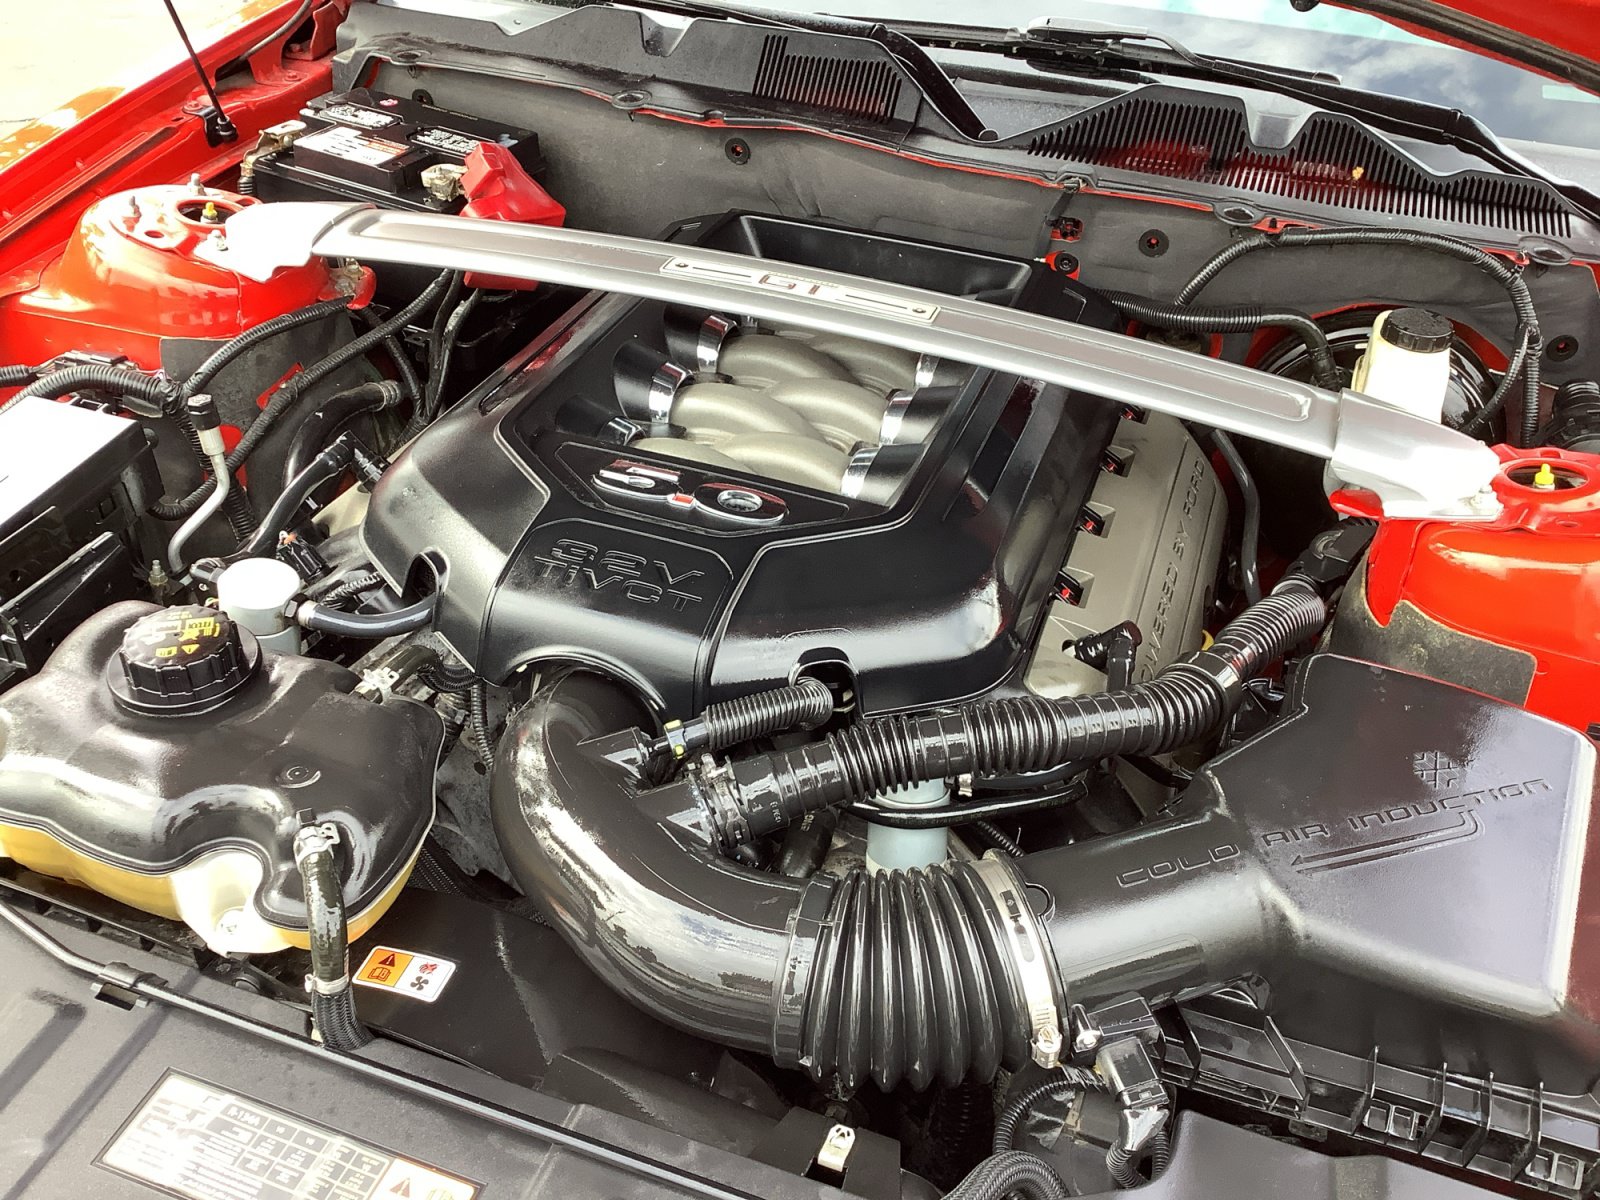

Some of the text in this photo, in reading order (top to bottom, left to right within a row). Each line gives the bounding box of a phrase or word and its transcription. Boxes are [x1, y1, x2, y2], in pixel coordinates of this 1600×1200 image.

[591, 459, 788, 524] 5.0
[1173, 519, 1189, 560] BY
[1183, 456, 1205, 519] FORD
[551, 538, 705, 585] 32V
[1116, 778, 1553, 888] COLD AIR INDUCTION
